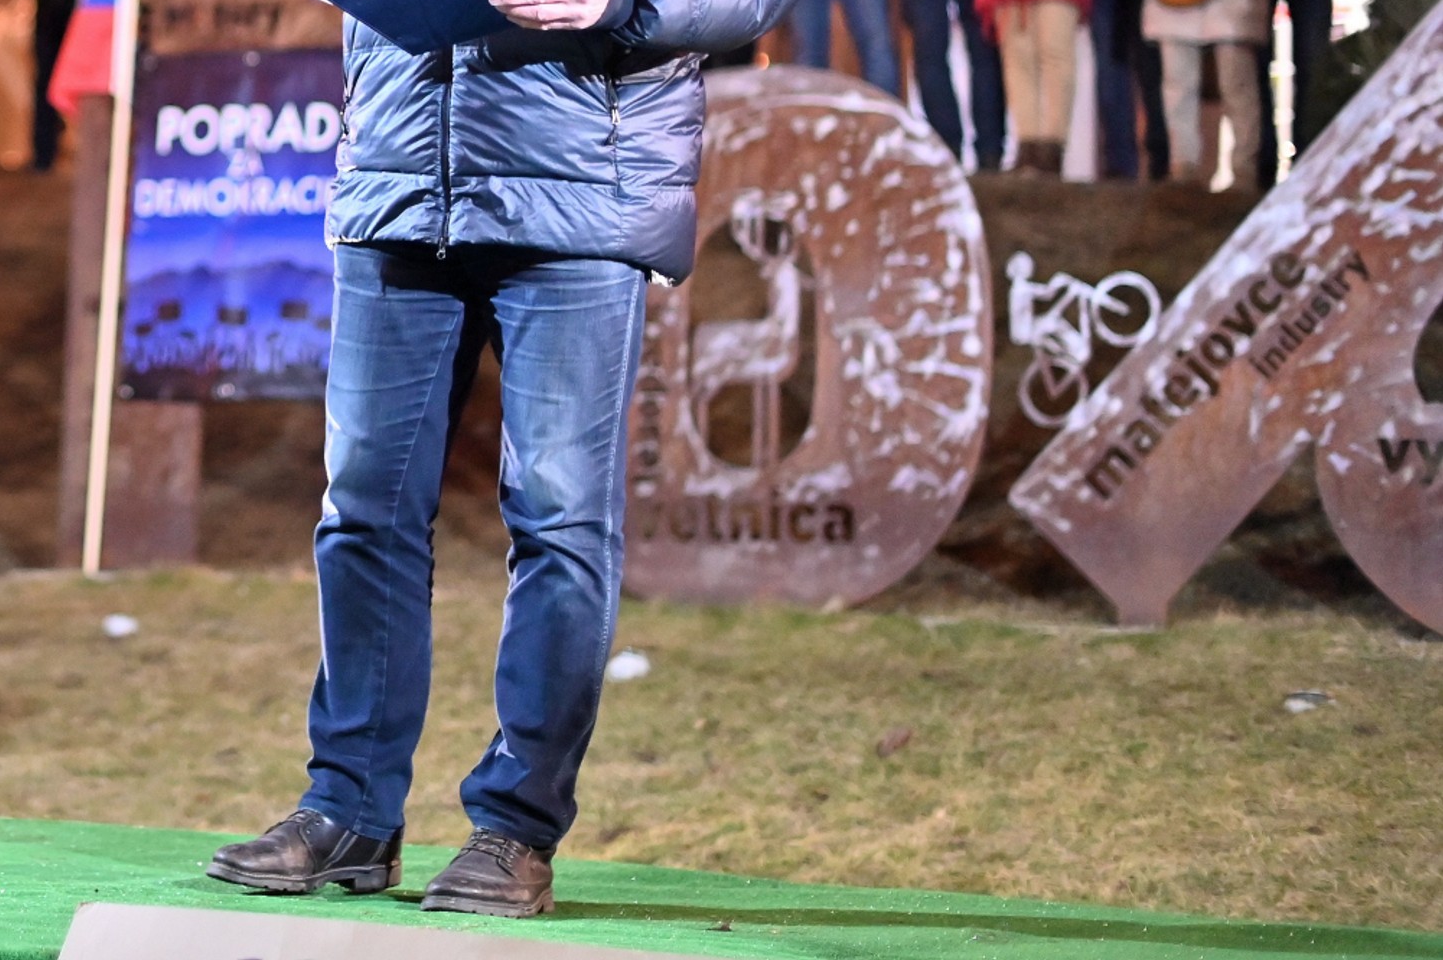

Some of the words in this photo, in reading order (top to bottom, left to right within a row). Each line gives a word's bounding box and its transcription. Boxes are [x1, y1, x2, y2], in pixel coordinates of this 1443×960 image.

[155, 101, 341, 157] POPRAD
[134, 174, 335, 218] DEMOKRACI
[1248, 249, 1370, 380] industry
[1083, 251, 1306, 499] matejovce
[633, 487, 856, 542] vetnica
